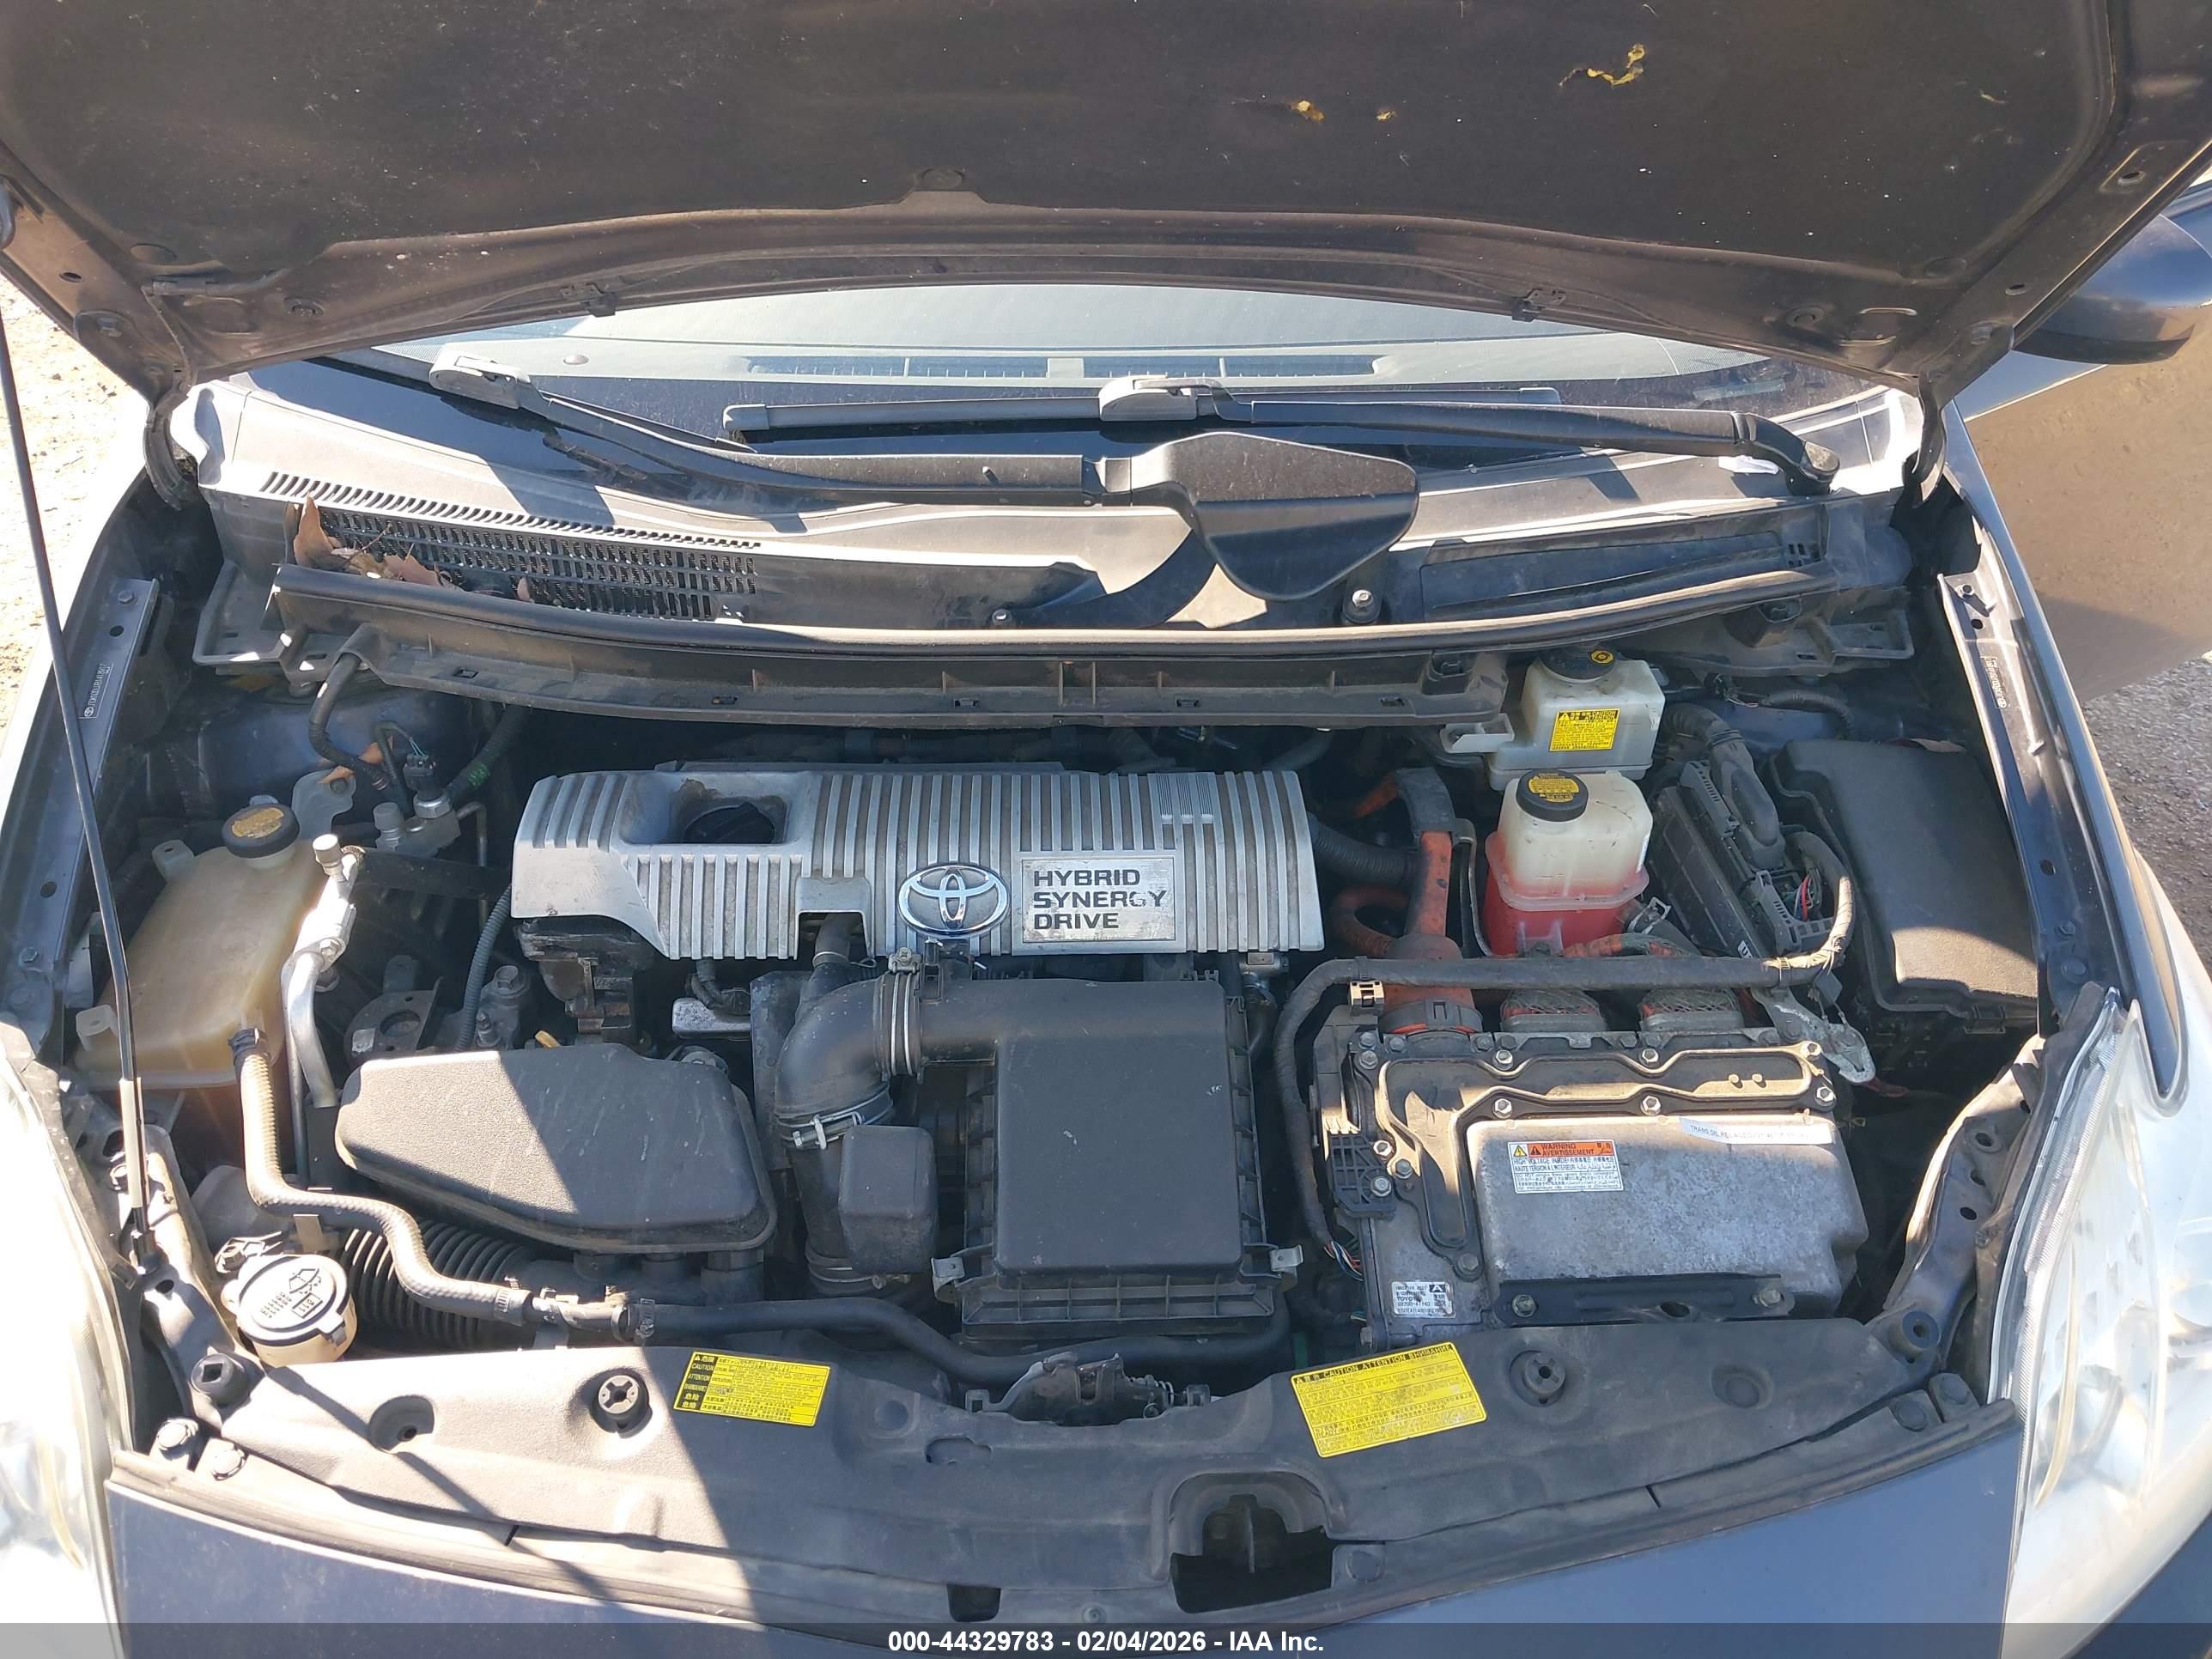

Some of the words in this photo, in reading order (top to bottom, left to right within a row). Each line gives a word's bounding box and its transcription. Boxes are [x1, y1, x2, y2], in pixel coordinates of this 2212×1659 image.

[1034, 869, 1140, 887] HYBRID
[1033, 890, 1167, 908] SYNERGY
[1034, 913, 1119, 930] DRIVE
[1542, 1148, 1595, 1157] AVERTISSEMENT
[691, 1363, 714, 1371] CAUTION
[1323, 1365, 1358, 1378] CAUTION
[1362, 1354, 1407, 1370] ATTENTION
[1408, 1344, 1452, 1360] ВНИМАНИЕ
[687, 1373, 711, 1382] ATTENTION
